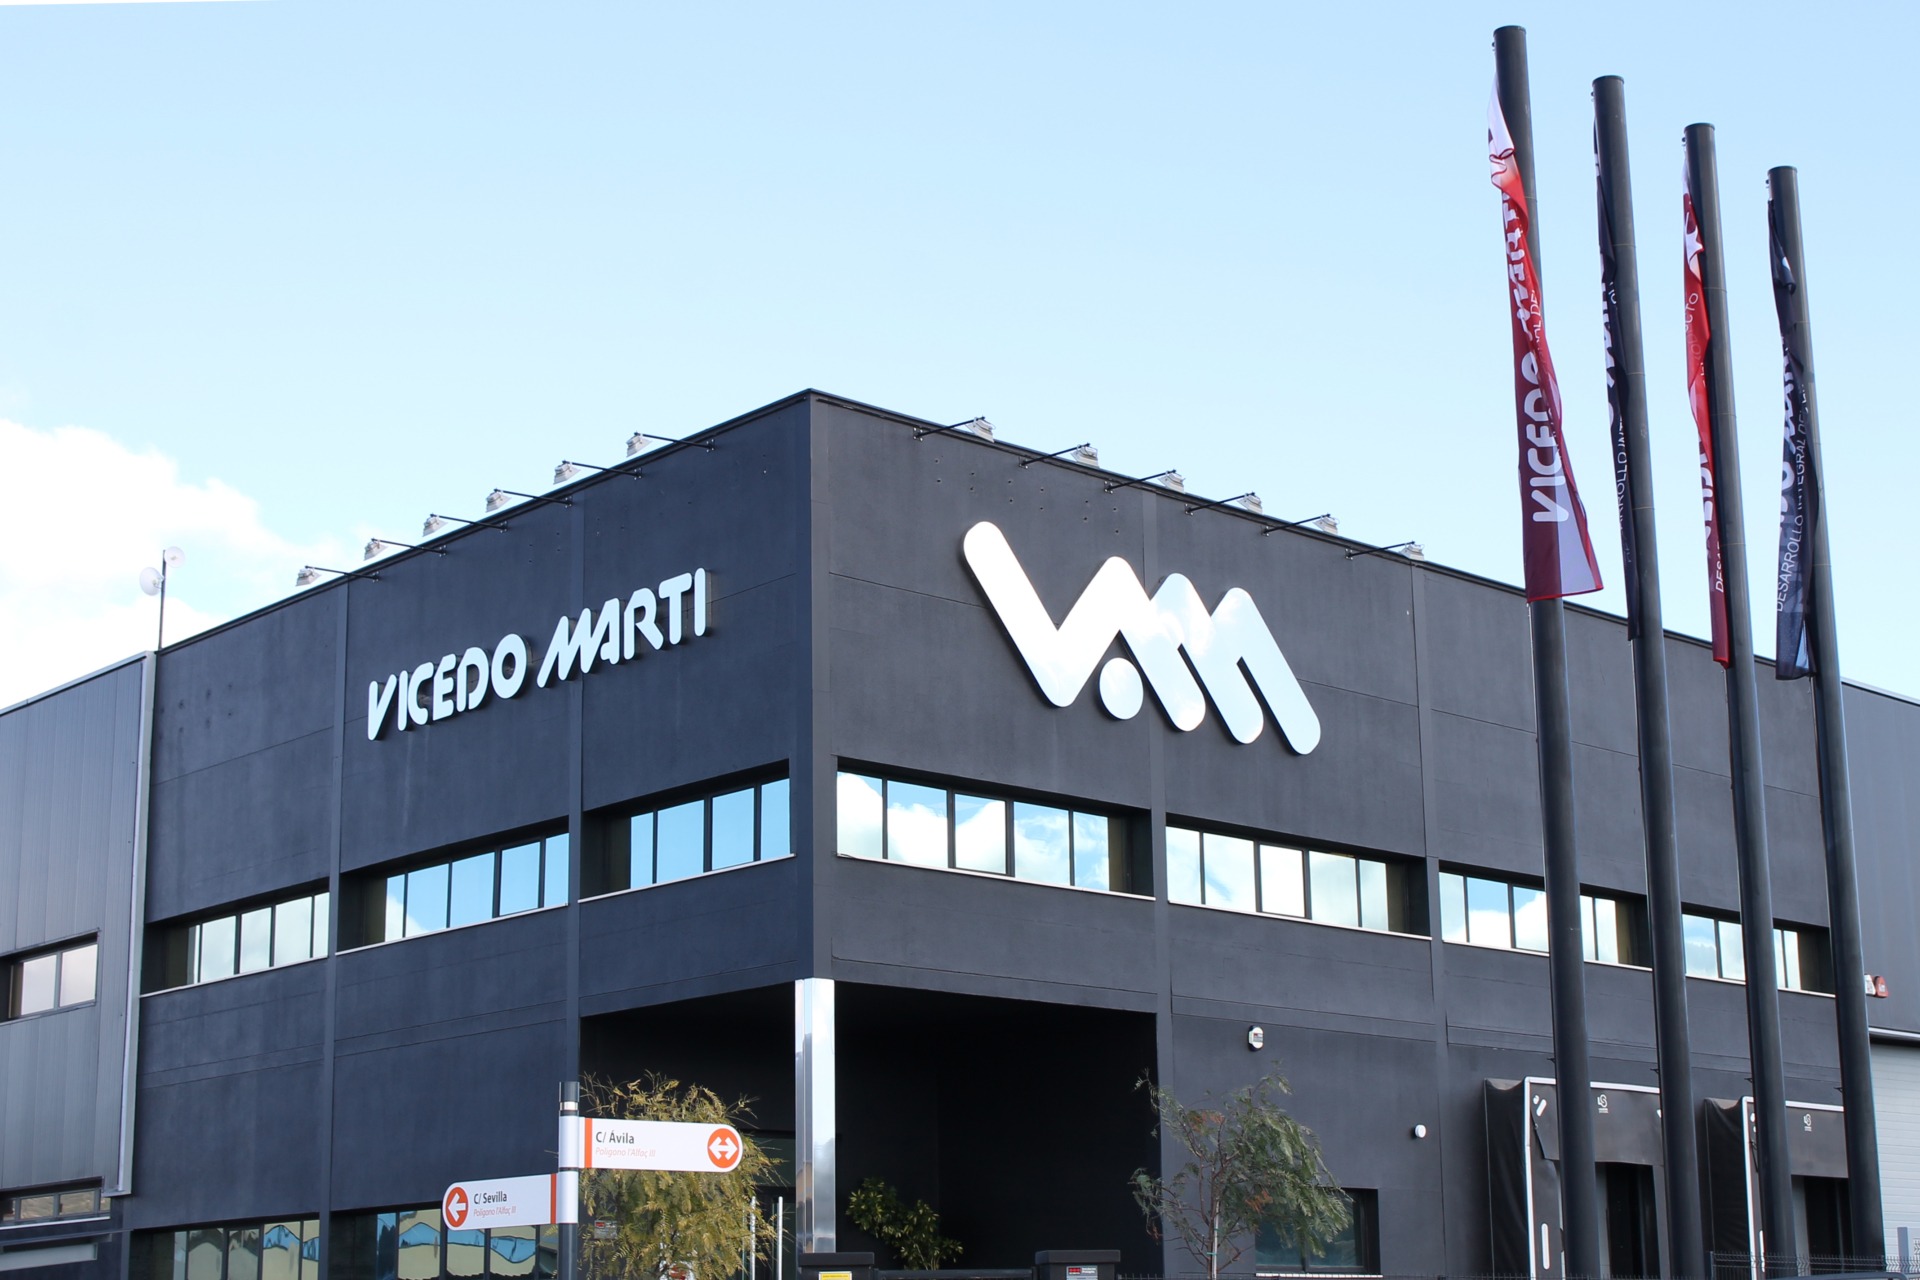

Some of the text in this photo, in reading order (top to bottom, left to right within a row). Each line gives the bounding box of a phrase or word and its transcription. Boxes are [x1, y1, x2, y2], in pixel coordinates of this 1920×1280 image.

[1796, 439, 1806, 509] EGRAL
[368, 567, 706, 740] VICEDO MARTI
[595, 1130, 635, 1144] C/ Ávila
[473, 1191, 508, 1205] C/ Sevilla
